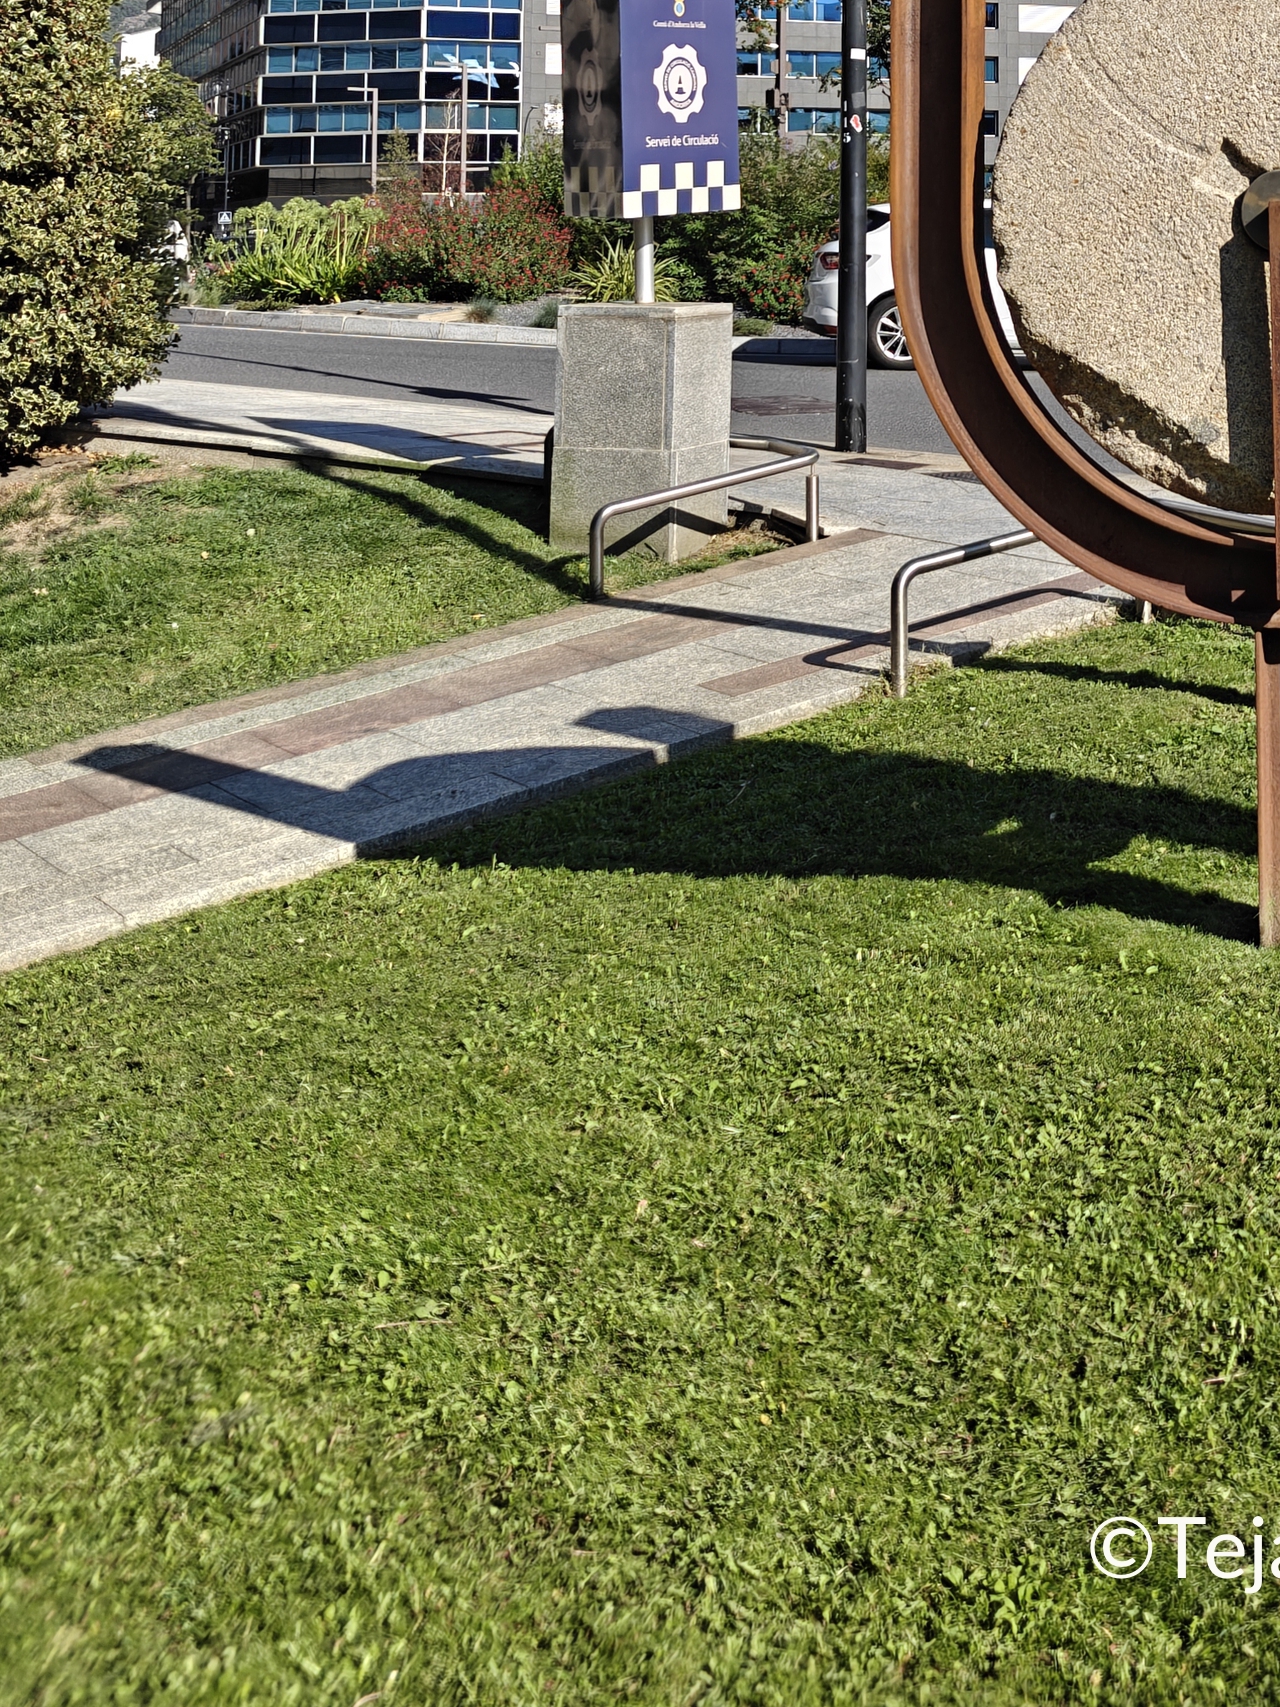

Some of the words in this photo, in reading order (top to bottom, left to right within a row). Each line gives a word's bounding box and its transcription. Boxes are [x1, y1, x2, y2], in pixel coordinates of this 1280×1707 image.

[645, 135, 671, 148] Servei
[671, 135, 682, 147] de
[682, 133, 719, 146] Circulació
